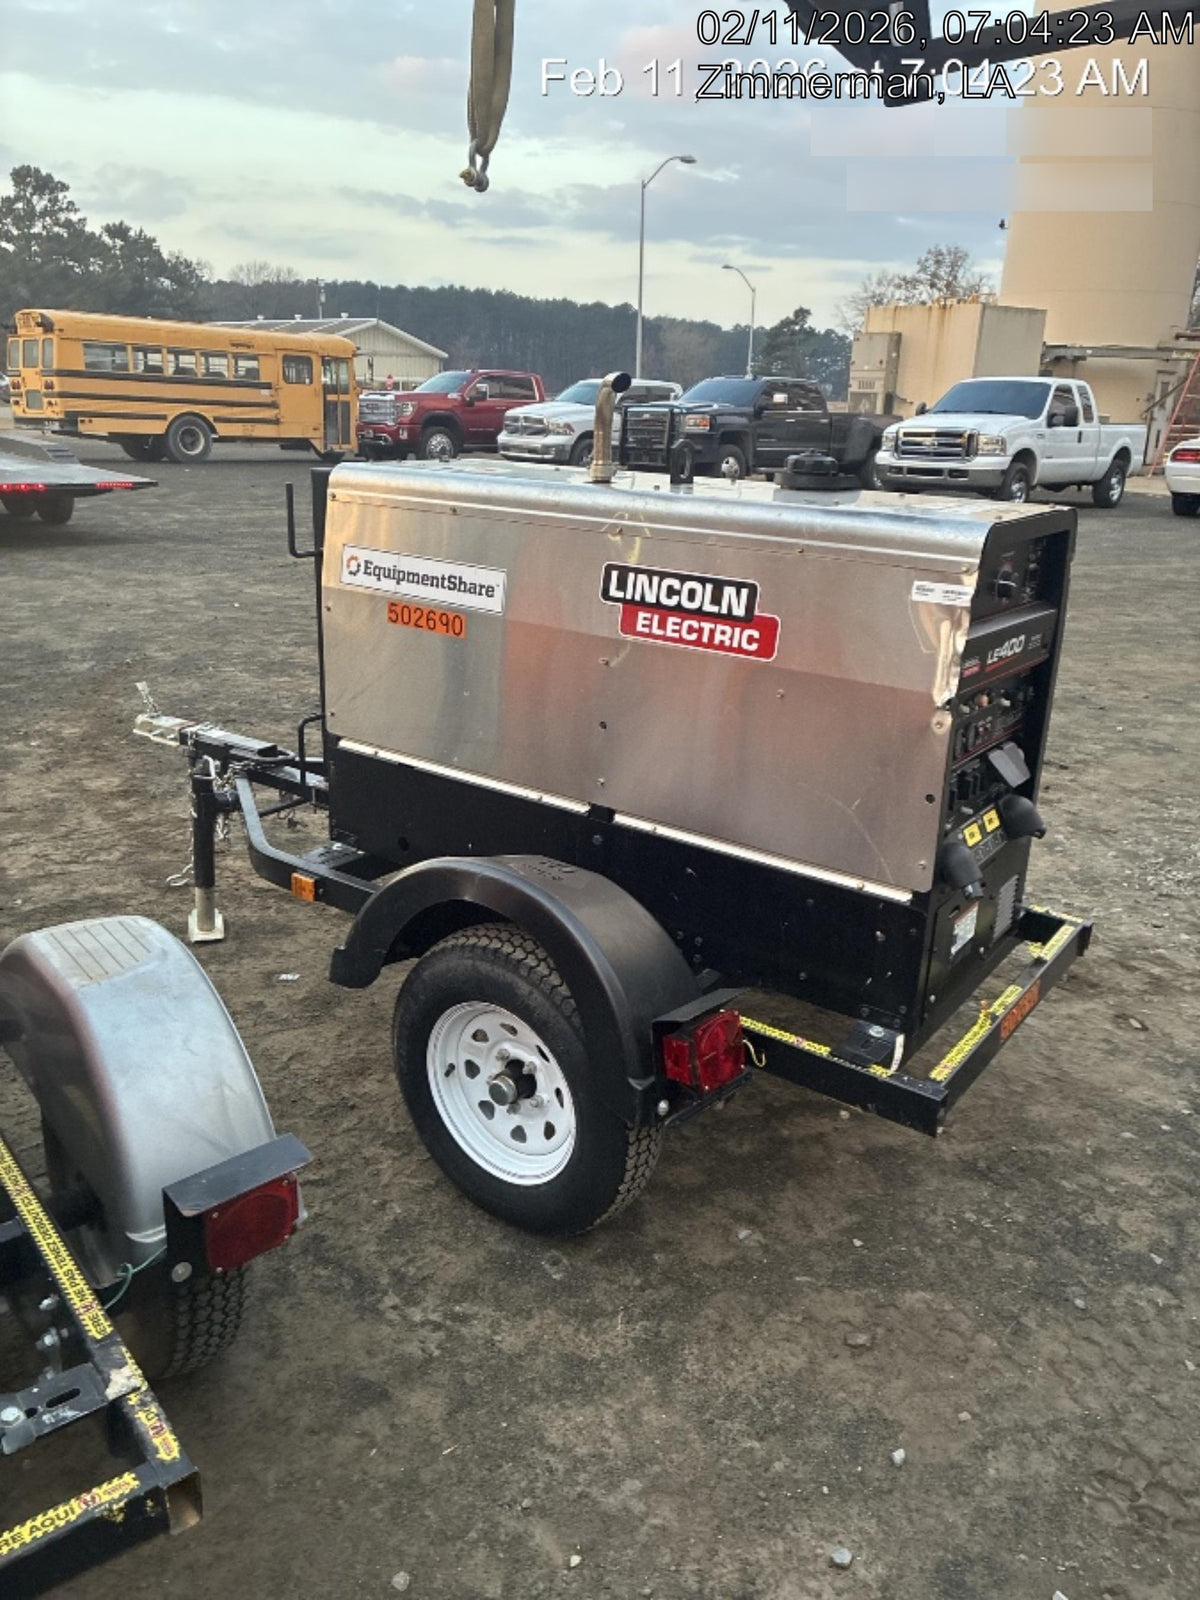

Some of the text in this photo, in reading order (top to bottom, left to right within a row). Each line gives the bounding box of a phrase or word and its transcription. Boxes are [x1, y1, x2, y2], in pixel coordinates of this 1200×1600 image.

[363, 560, 496, 598] EquipmentShare
[608, 570, 750, 618] LINCOLN
[388, 602, 464, 636] 502690
[636, 611, 761, 652] ELECTRIC
[28, 1505, 77, 1532] AQUI
